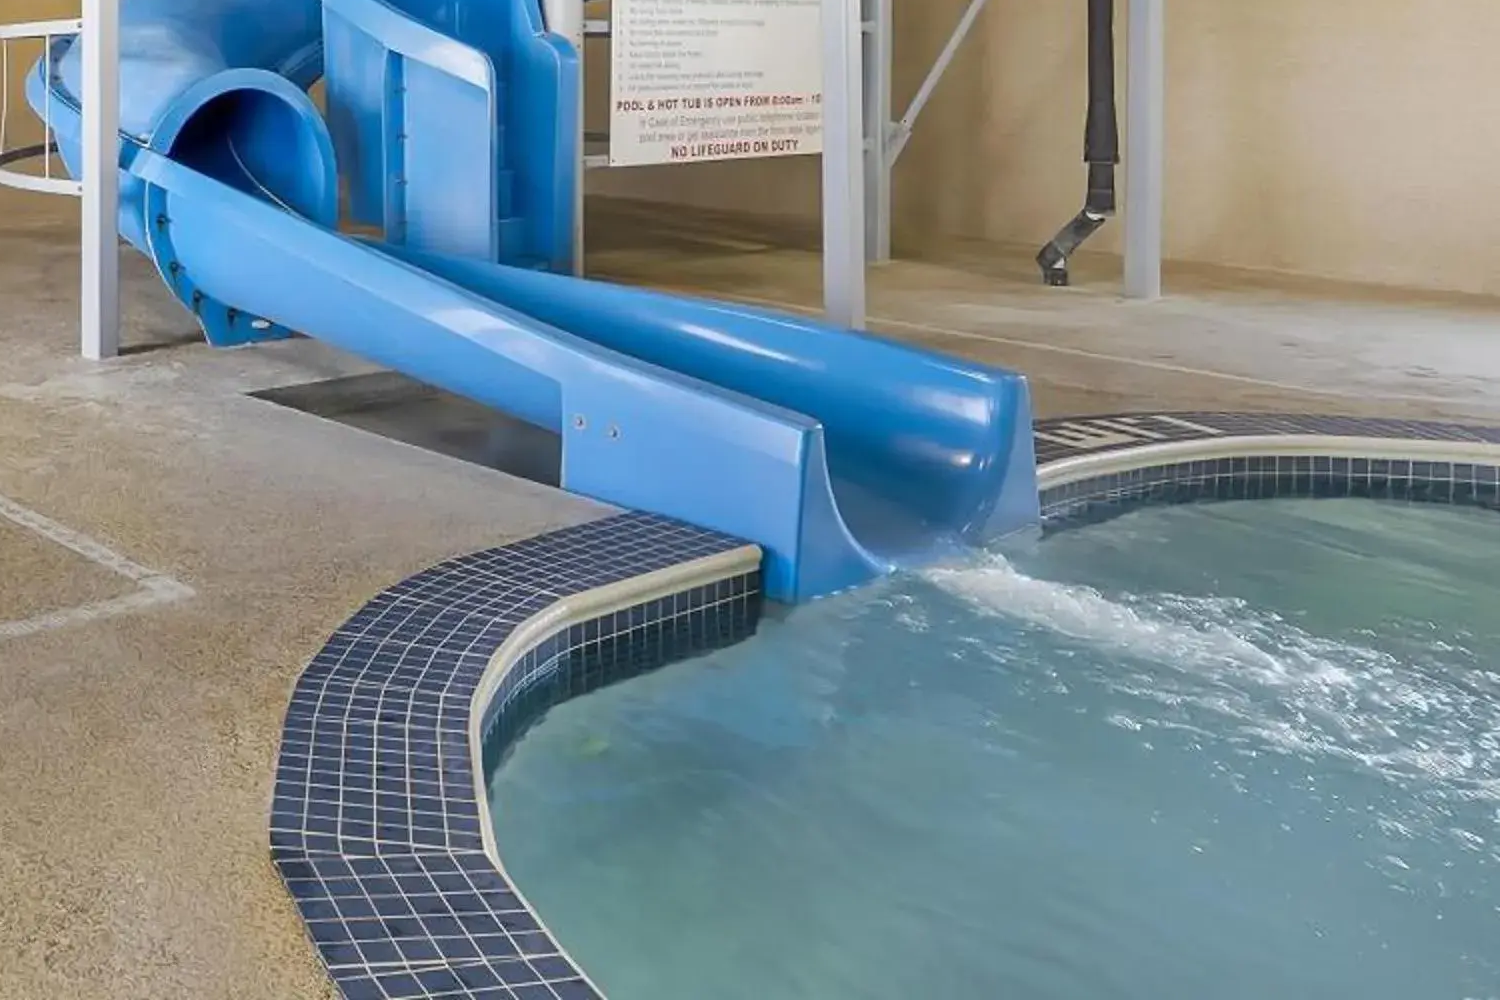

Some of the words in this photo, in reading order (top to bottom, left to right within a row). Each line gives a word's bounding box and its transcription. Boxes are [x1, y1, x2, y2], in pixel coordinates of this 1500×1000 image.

[616, 99, 645, 111] POOL
[647, 98, 656, 111] &
[657, 98, 680, 111] HOT
[681, 97, 701, 110] TUB
[703, 97, 714, 109] IS
[716, 96, 742, 108] OPEN
[744, 95, 771, 107] FROM
[671, 145, 688, 158] NO
[690, 140, 750, 157] LIFEGUARD
[753, 140, 768, 153] ON
[771, 138, 799, 152] DUTY
